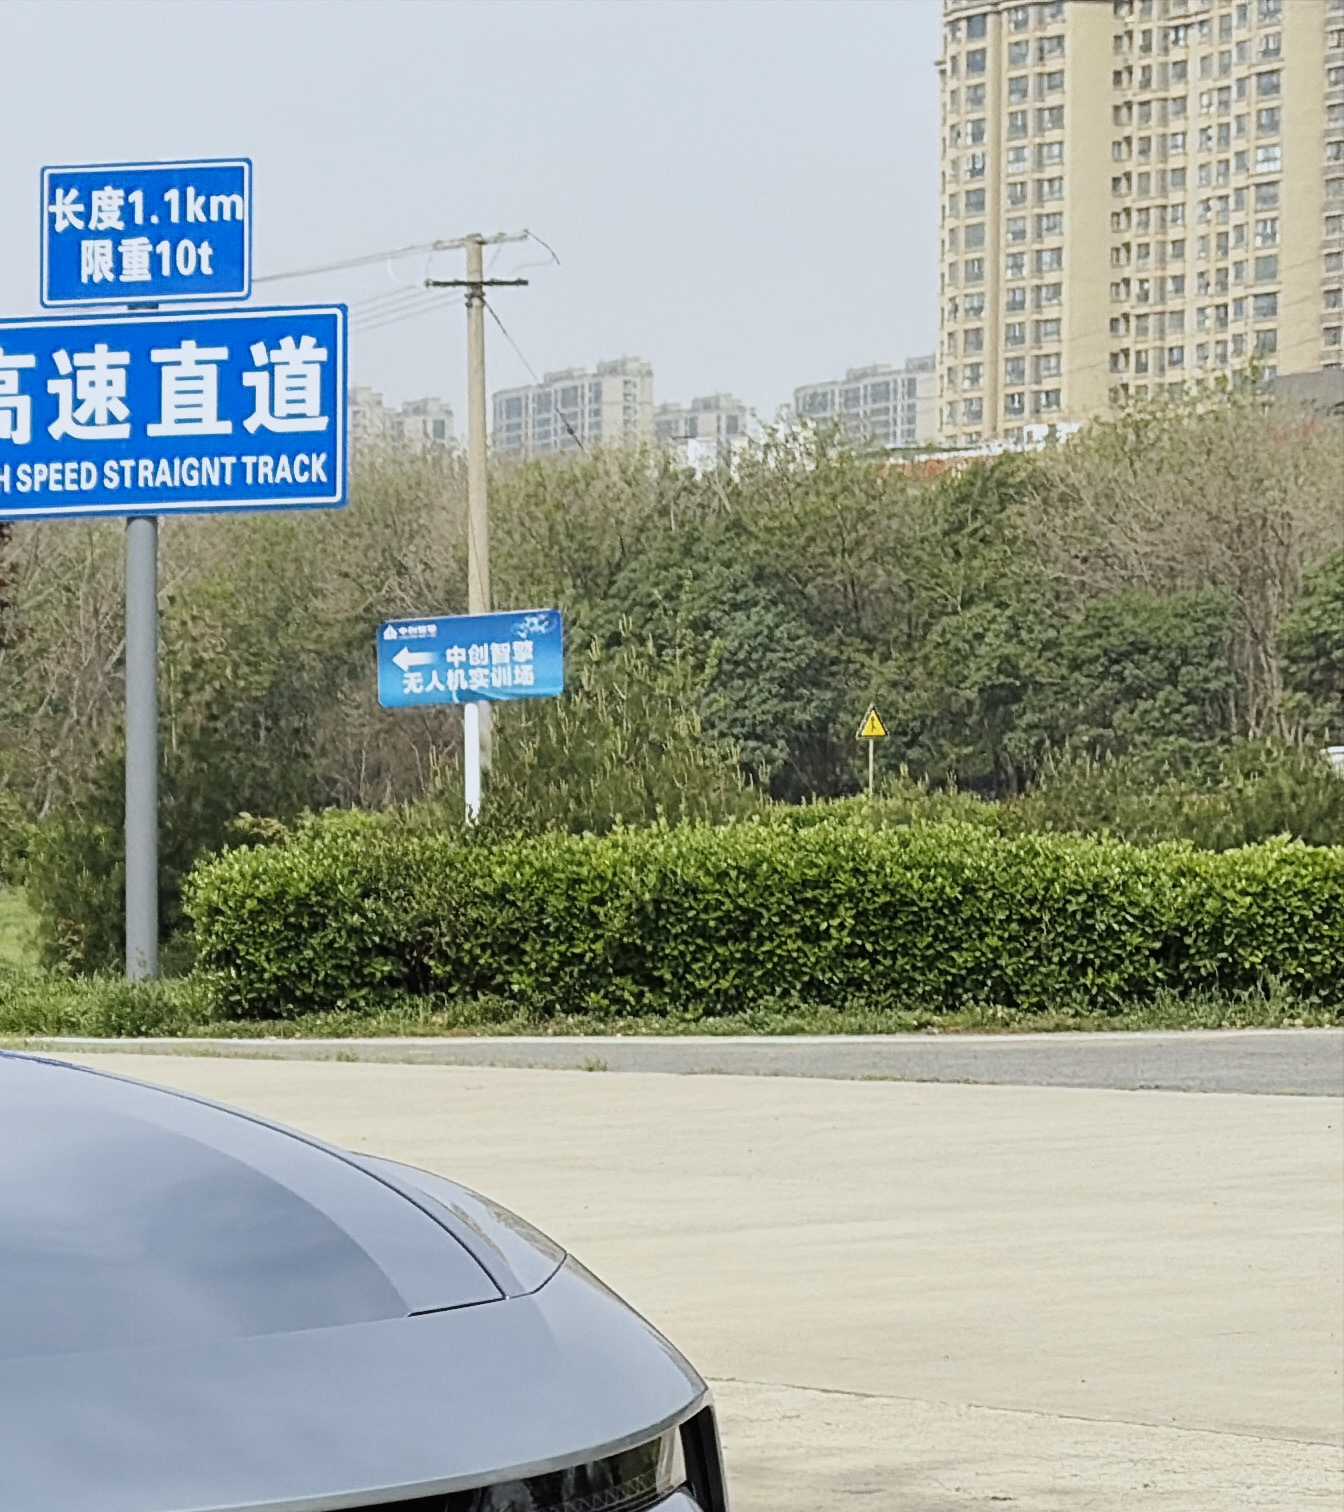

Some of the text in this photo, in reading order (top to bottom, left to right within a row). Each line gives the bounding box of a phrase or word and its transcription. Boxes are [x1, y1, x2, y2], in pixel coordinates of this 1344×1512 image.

[48, 186, 244, 233] 长度1.1km
[80, 236, 214, 284] 限重10t
[15, 461, 98, 493] SPEED
[102, 455, 237, 489] STRAIGNT
[241, 452, 328, 485] TRACK
[402, 664, 534, 695] 无人机实训场
